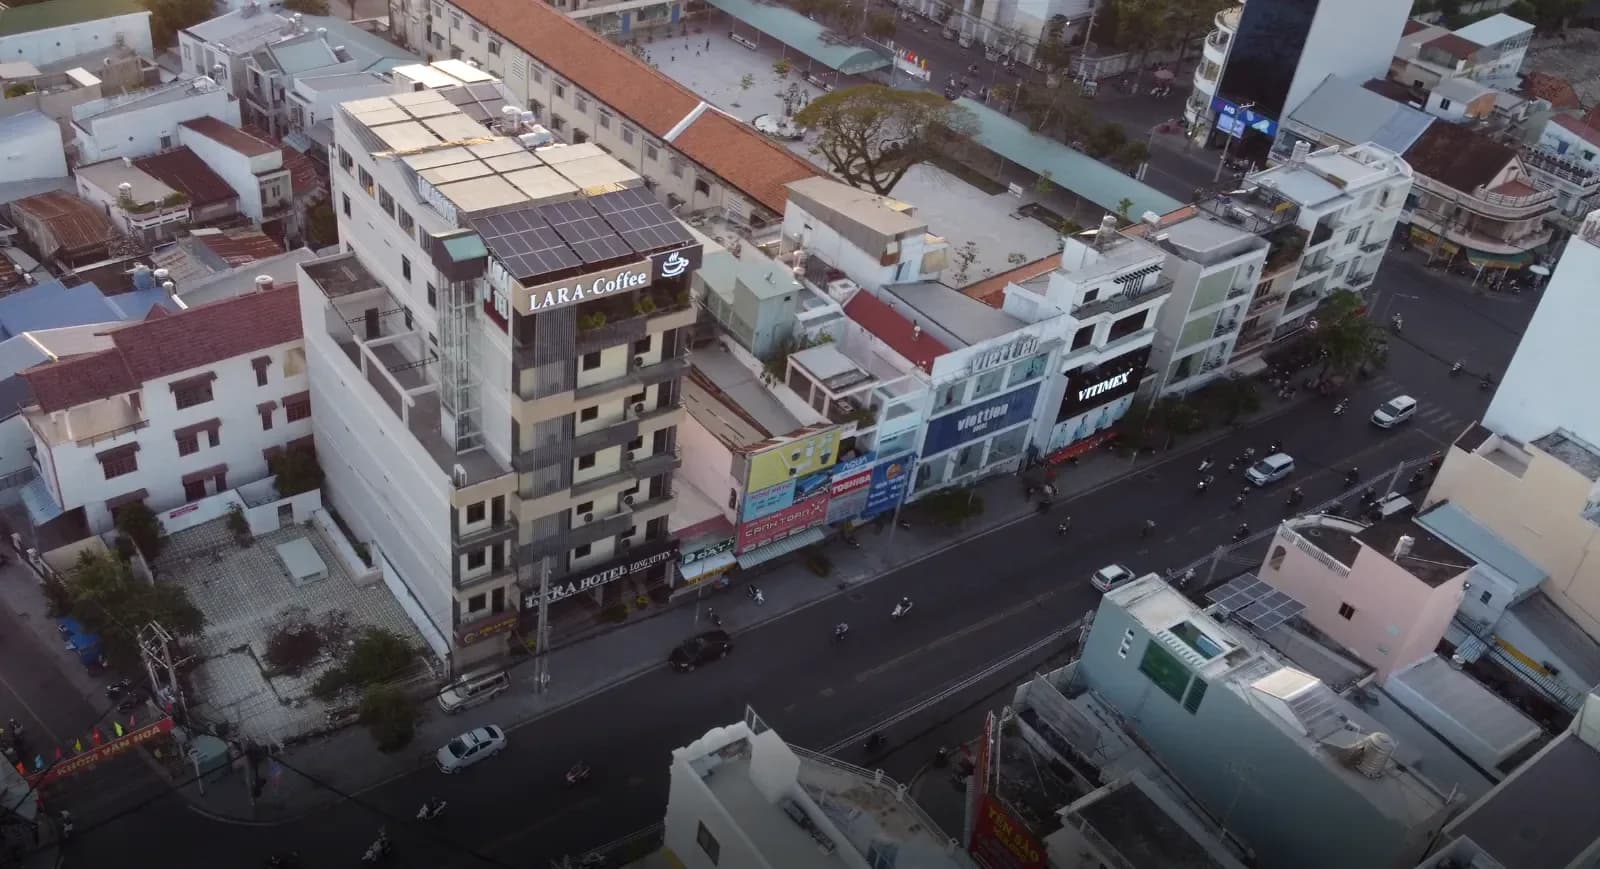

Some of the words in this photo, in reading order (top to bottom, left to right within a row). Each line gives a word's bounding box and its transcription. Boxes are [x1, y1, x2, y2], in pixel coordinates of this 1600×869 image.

[529, 270, 647, 311] LARA-Coffee
[1078, 370, 1131, 402] VITIMEX
[832, 474, 871, 494] TOSHIBA
[580, 565, 628, 589] HOTEL
